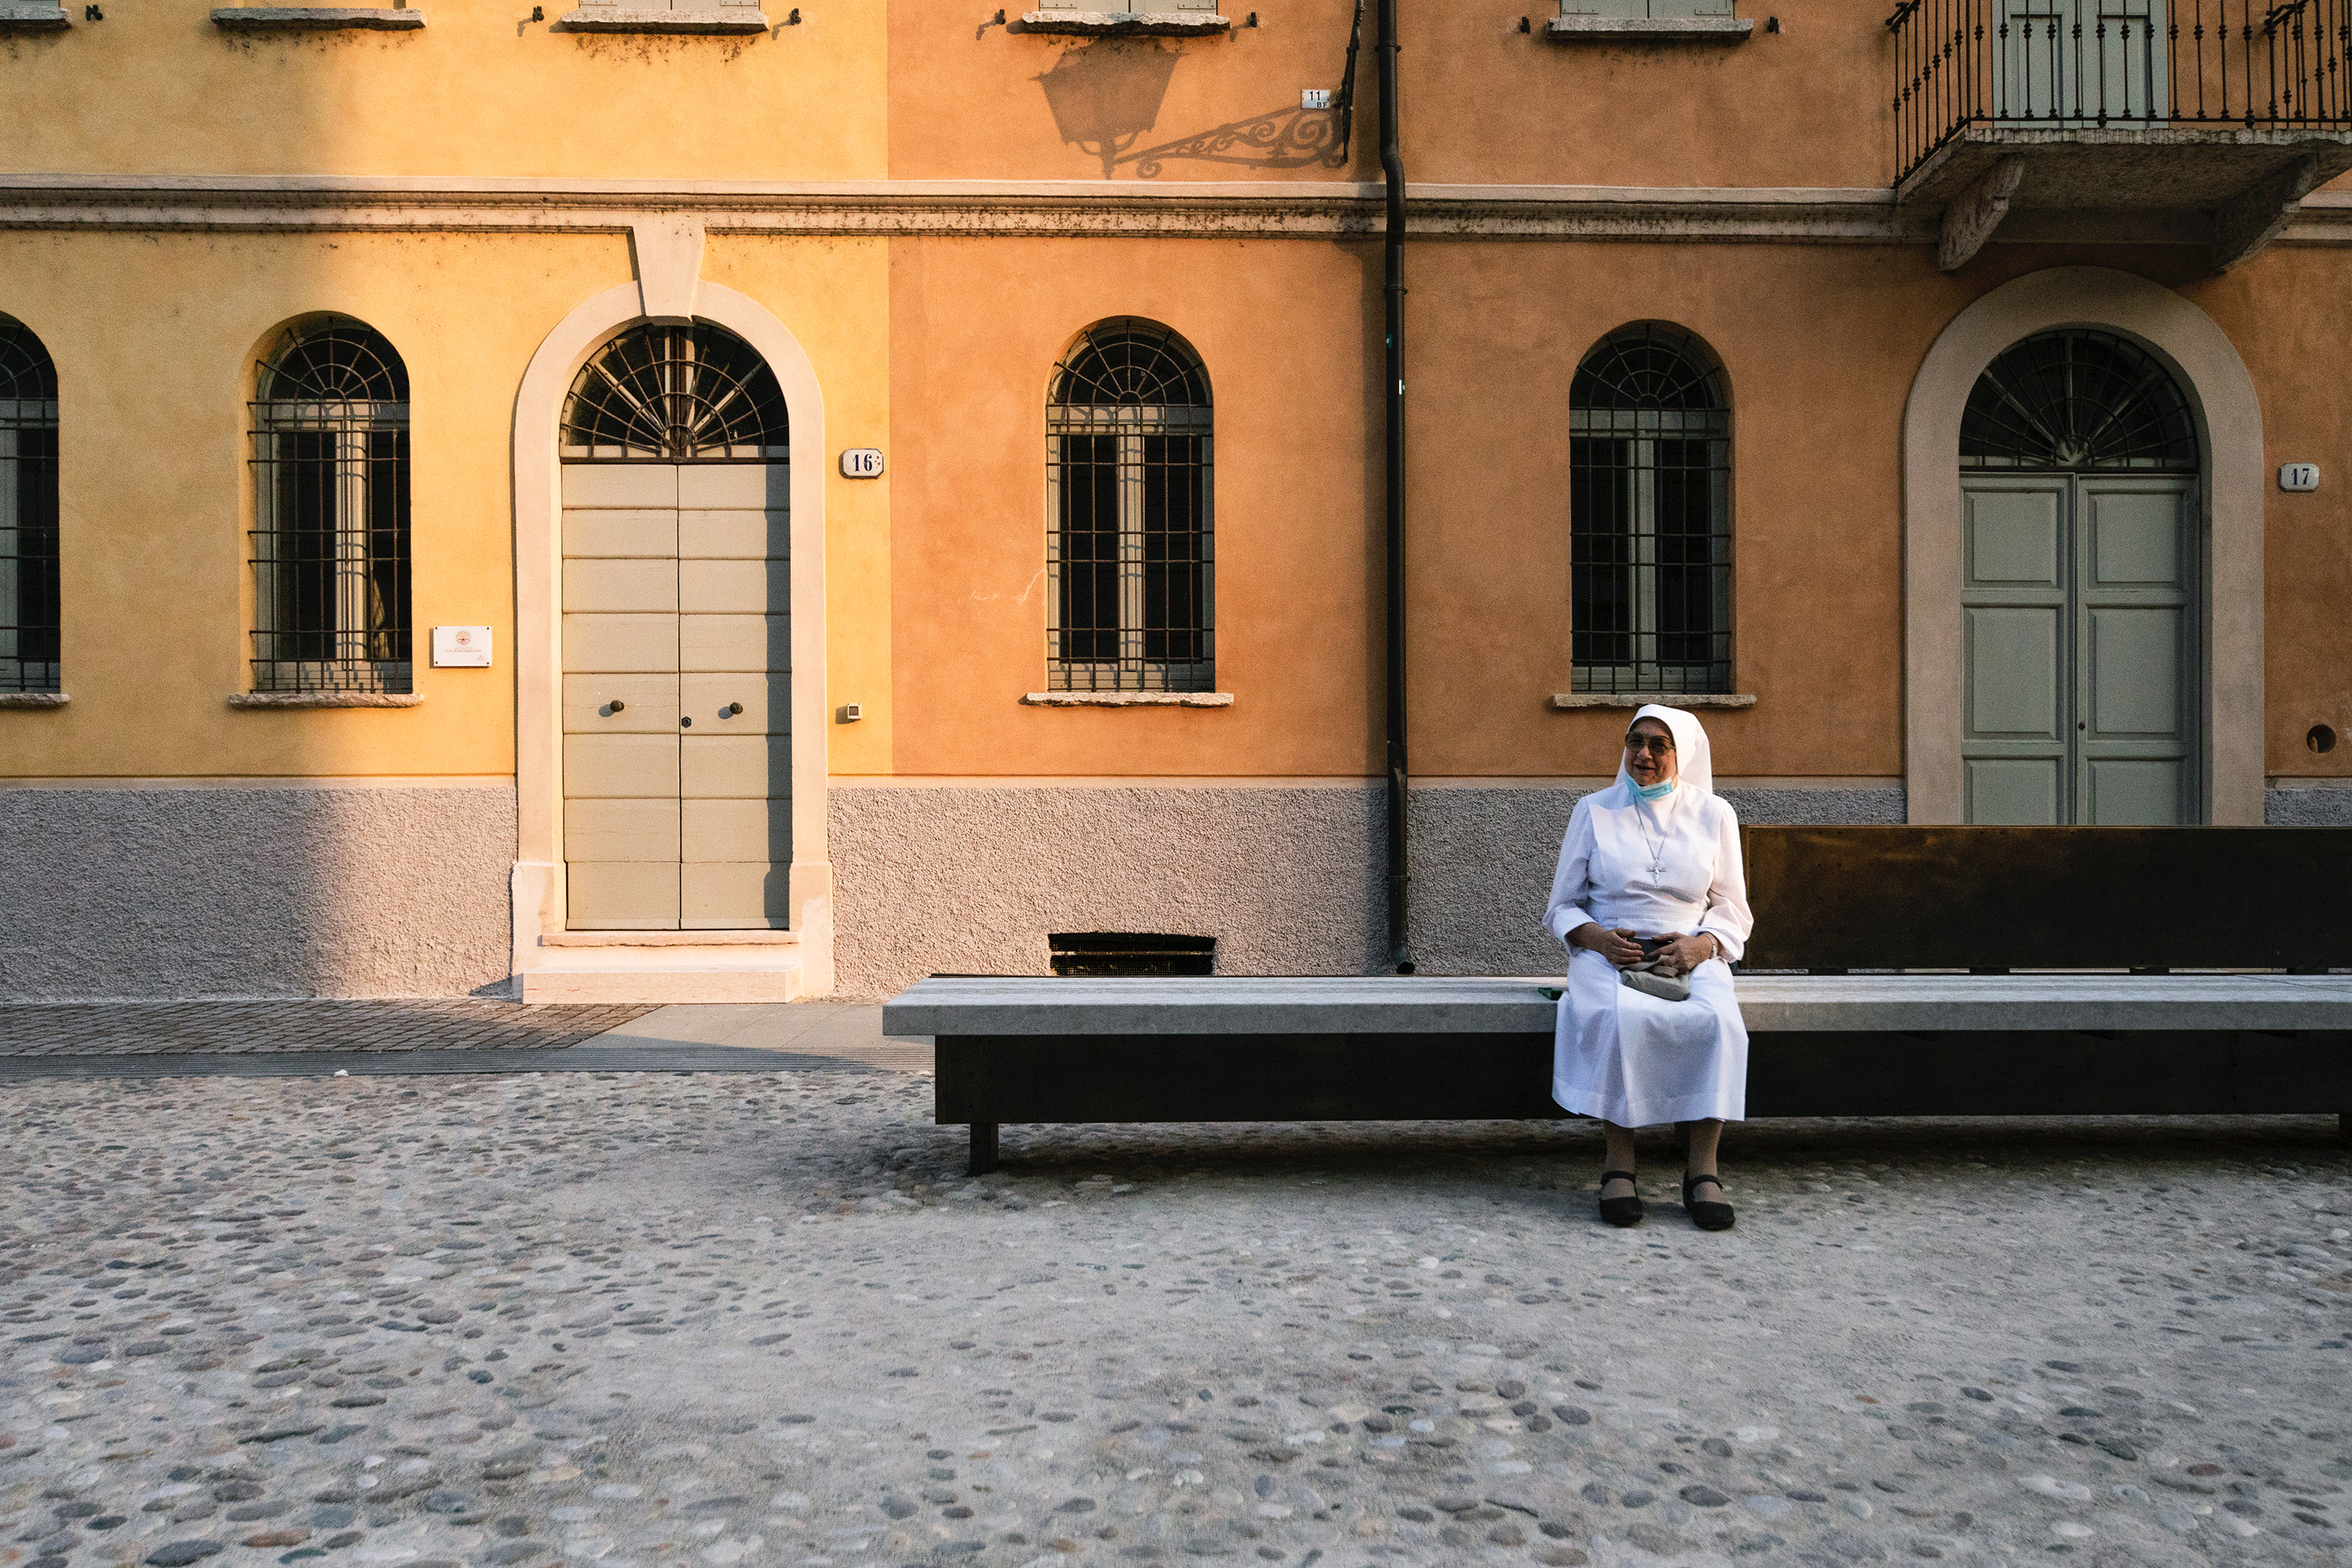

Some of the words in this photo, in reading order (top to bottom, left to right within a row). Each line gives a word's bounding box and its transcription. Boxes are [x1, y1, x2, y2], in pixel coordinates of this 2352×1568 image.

[1309, 91, 1320, 101] 11
[852, 454, 872, 472] 16
[2291, 468, 2309, 486] 17
